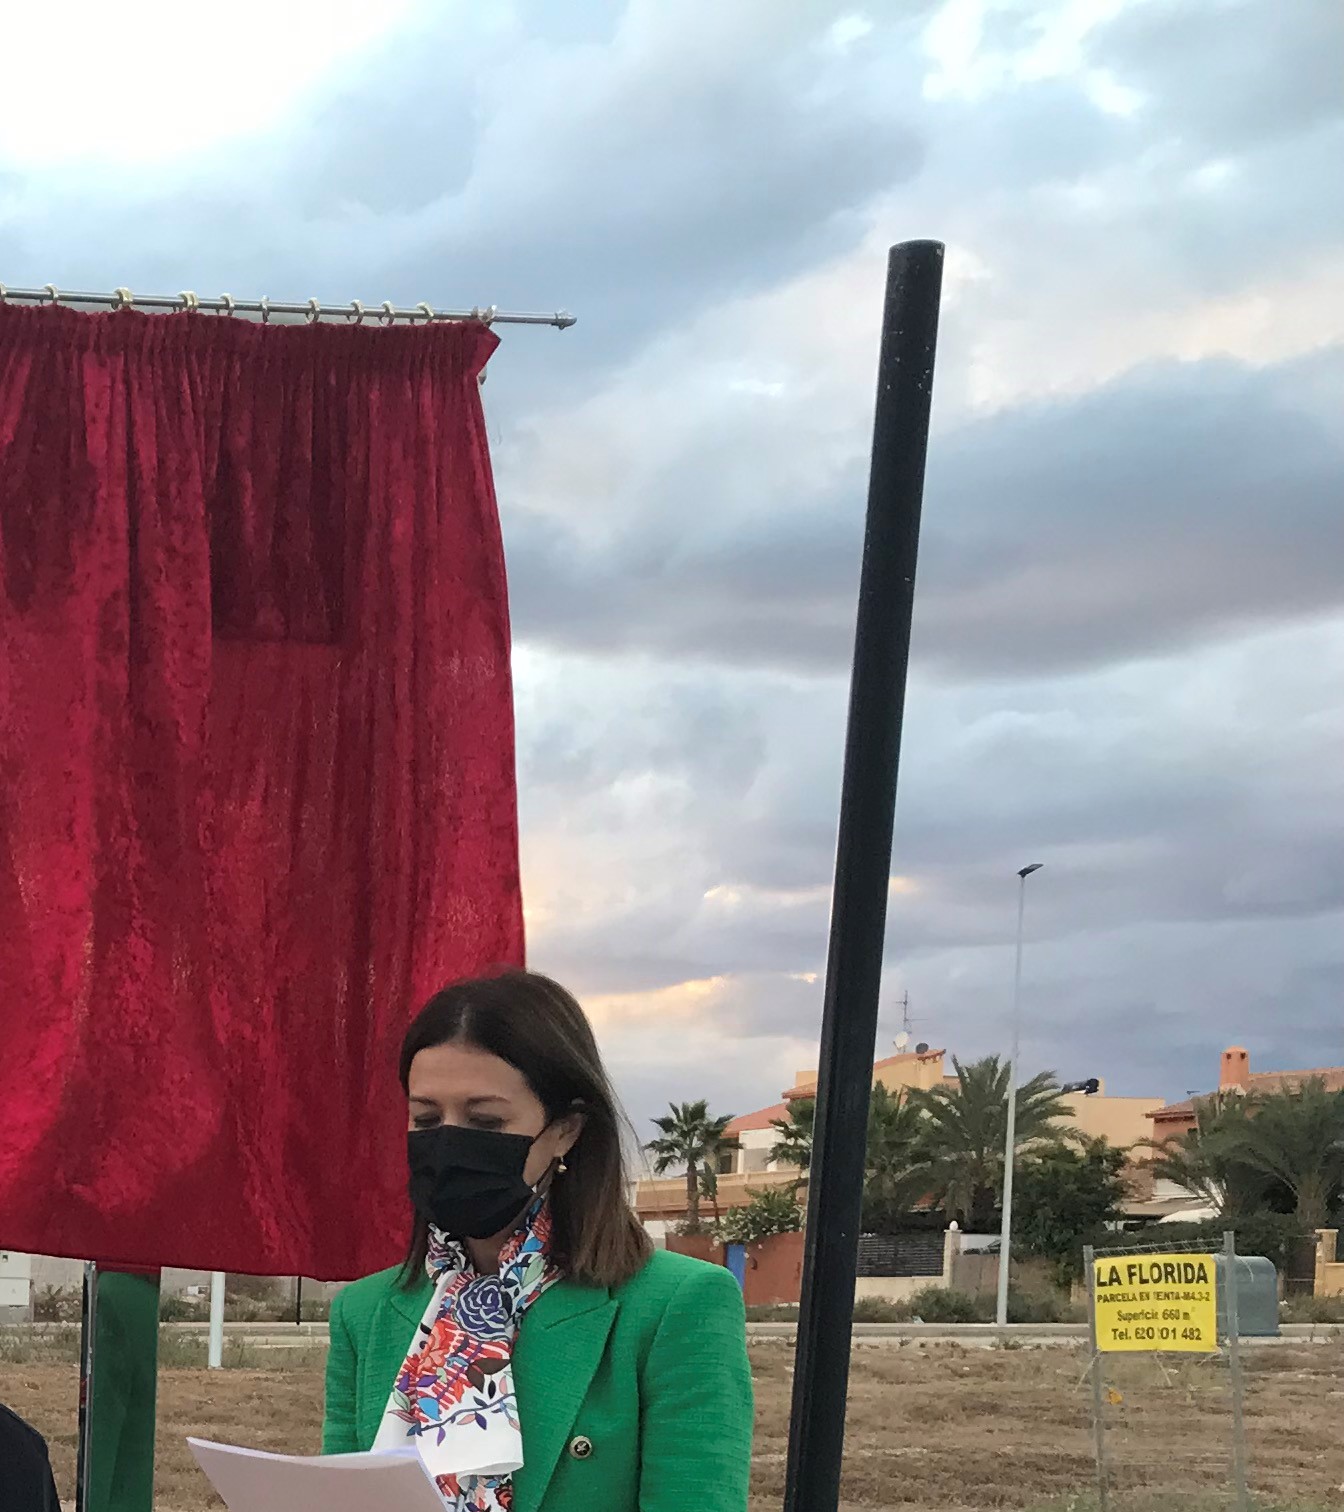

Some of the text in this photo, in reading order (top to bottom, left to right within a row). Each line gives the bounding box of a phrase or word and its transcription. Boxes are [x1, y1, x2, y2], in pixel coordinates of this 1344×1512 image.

[1096, 1262, 1209, 1287] LA FLORIDA
[1097, 1292, 1137, 1303] PARCELA
[1139, 1291, 1150, 1301] EN
[1111, 1328, 1131, 1340] Tel.
